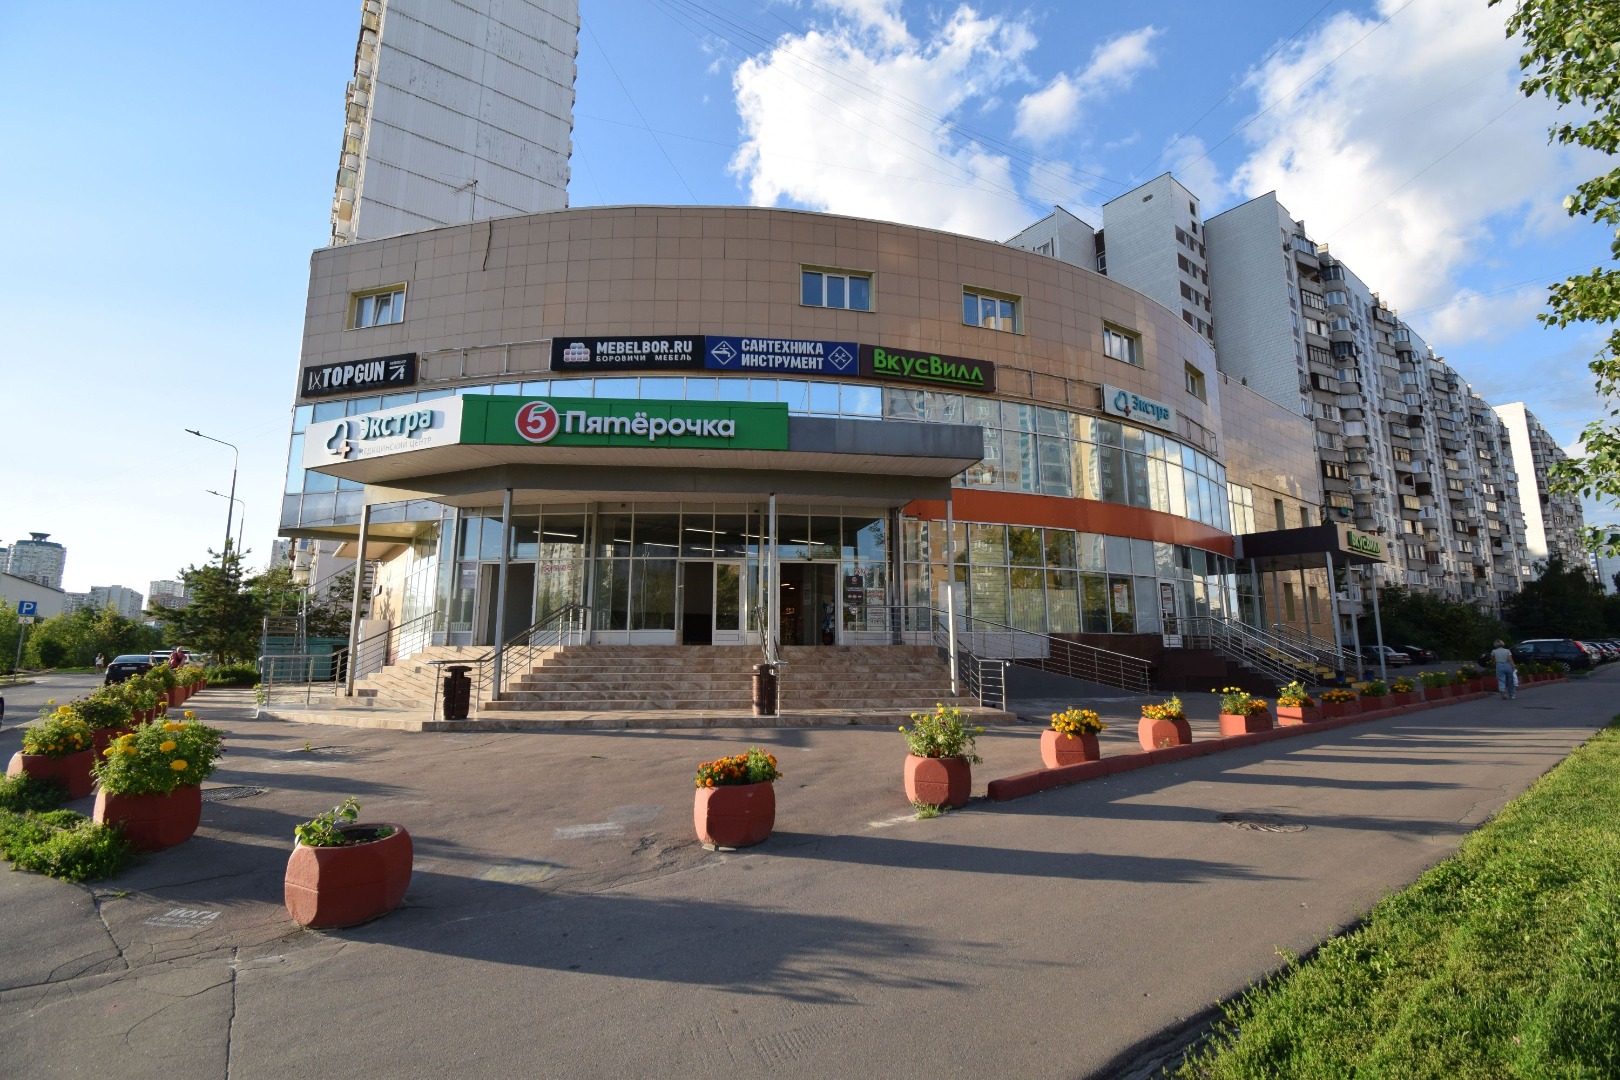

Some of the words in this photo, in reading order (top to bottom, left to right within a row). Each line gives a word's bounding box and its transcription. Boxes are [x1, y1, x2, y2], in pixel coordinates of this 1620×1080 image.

[596, 341, 693, 355] MEBELBOR.RU
[741, 339, 825, 355] САНТЕХНИКА
[655, 354, 692, 362] МЕБЕЛЬ
[741, 354, 825, 369] ИНСТРУМЕНТ
[873, 348, 984, 382] ВкусВилл
[322, 360, 385, 388] TOPGUN
[1132, 395, 1170, 421] Экстра
[359, 409, 434, 440] Экстра
[565, 410, 736, 442] Пятёрочка
[409, 437, 433, 449] ЦЕНТР
[22, 602, 34, 614] P
